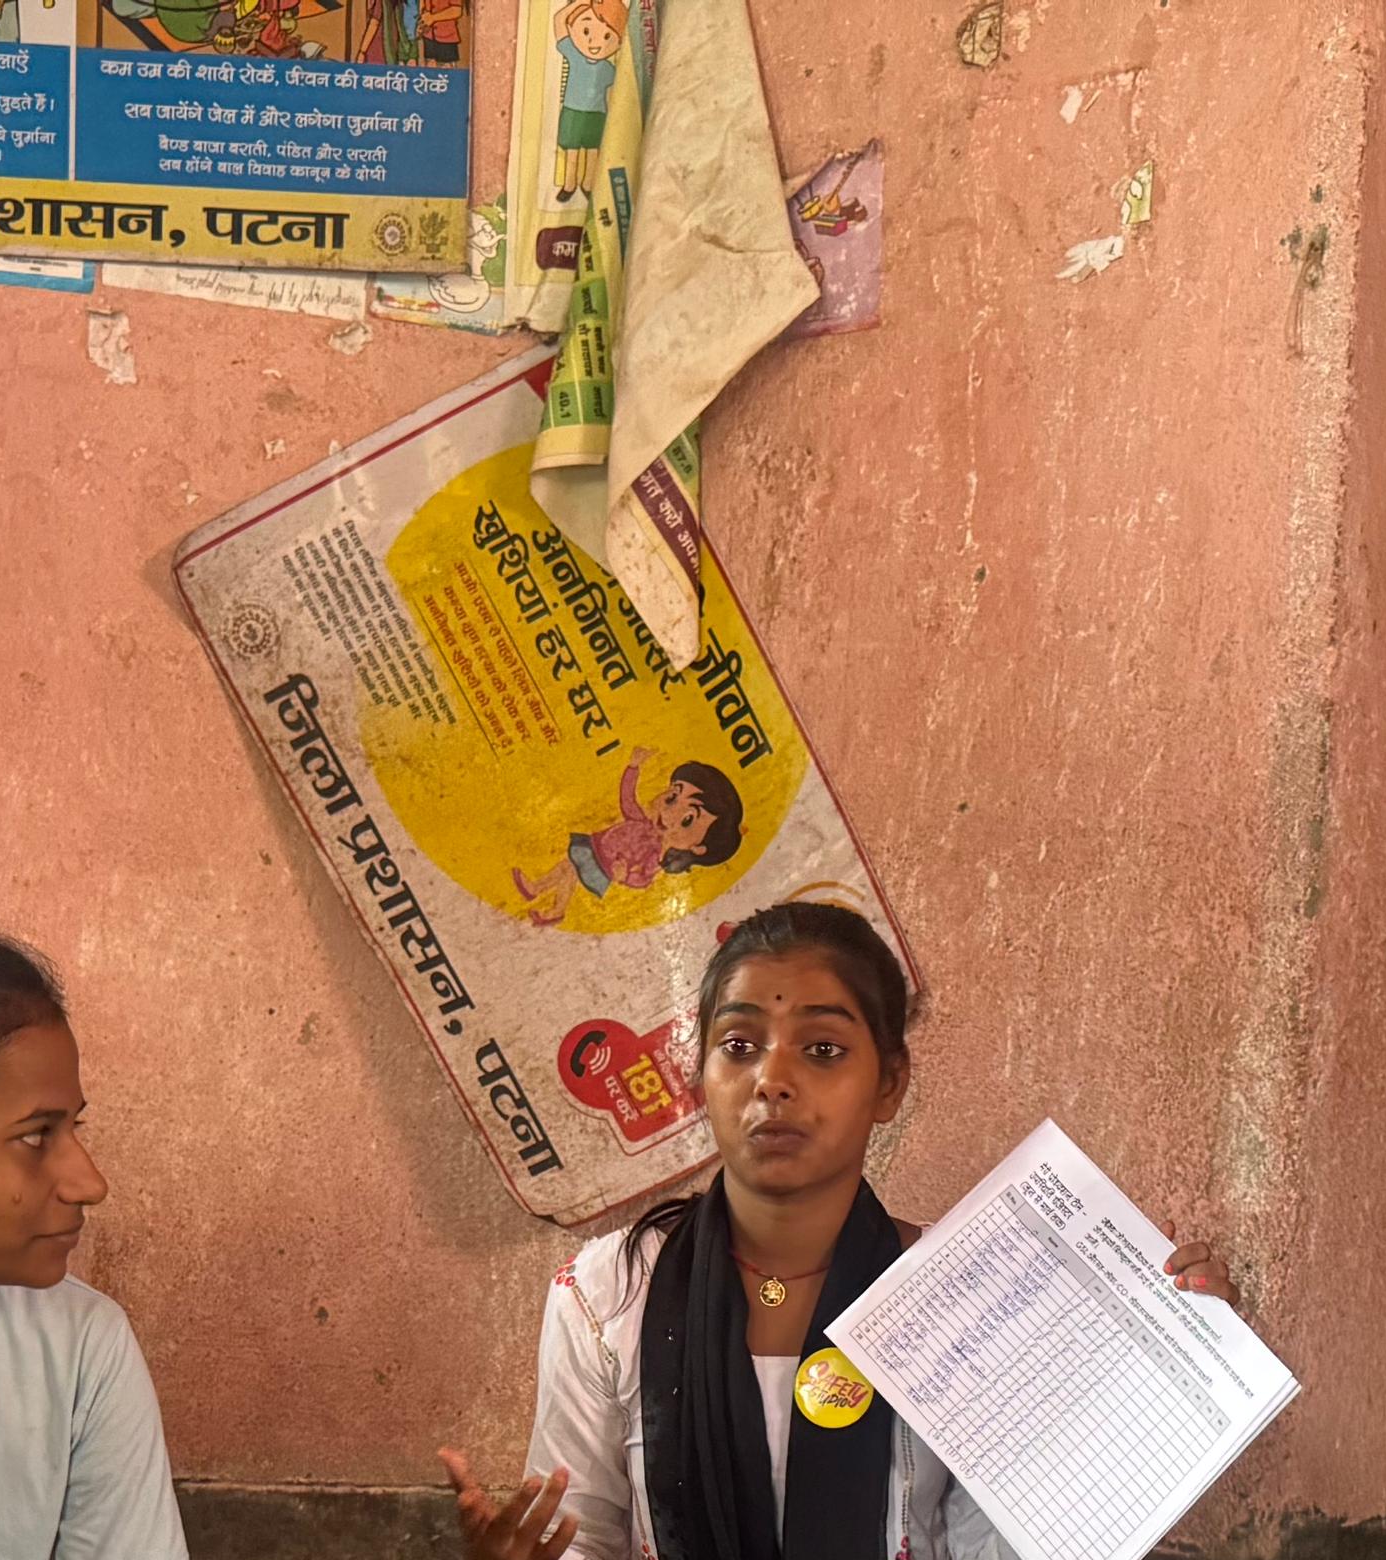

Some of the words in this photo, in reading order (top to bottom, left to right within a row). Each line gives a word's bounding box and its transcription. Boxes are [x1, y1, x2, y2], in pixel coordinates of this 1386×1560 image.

[100, 60, 133, 75] कम
[166, 58, 192, 79] की
[195, 61, 236, 82] शादी
[334, 68, 359, 89] की
[412, 72, 449, 94] रोकें
[207, 102, 237, 124] जेल
[240, 104, 255, 124] में
[258, 105, 290, 127] और
[294, 107, 344, 128] लगेगा
[347, 111, 398, 136] जुर्माना
[402, 112, 423, 132] भी
[202, 206, 349, 249] पटना
[472, 499, 558, 623] खुशियां
[535, 623, 581, 681] हर
[567, 679, 611, 738] घर
[531, 523, 637, 689] अनगिनत
[262, 673, 363, 815] जिला
[336, 813, 475, 1035] प्रशासन,
[475, 1037, 564, 1176] पटना
[615, 1050, 674, 1119] 181
[799, 1361, 868, 1408] SAFETY
